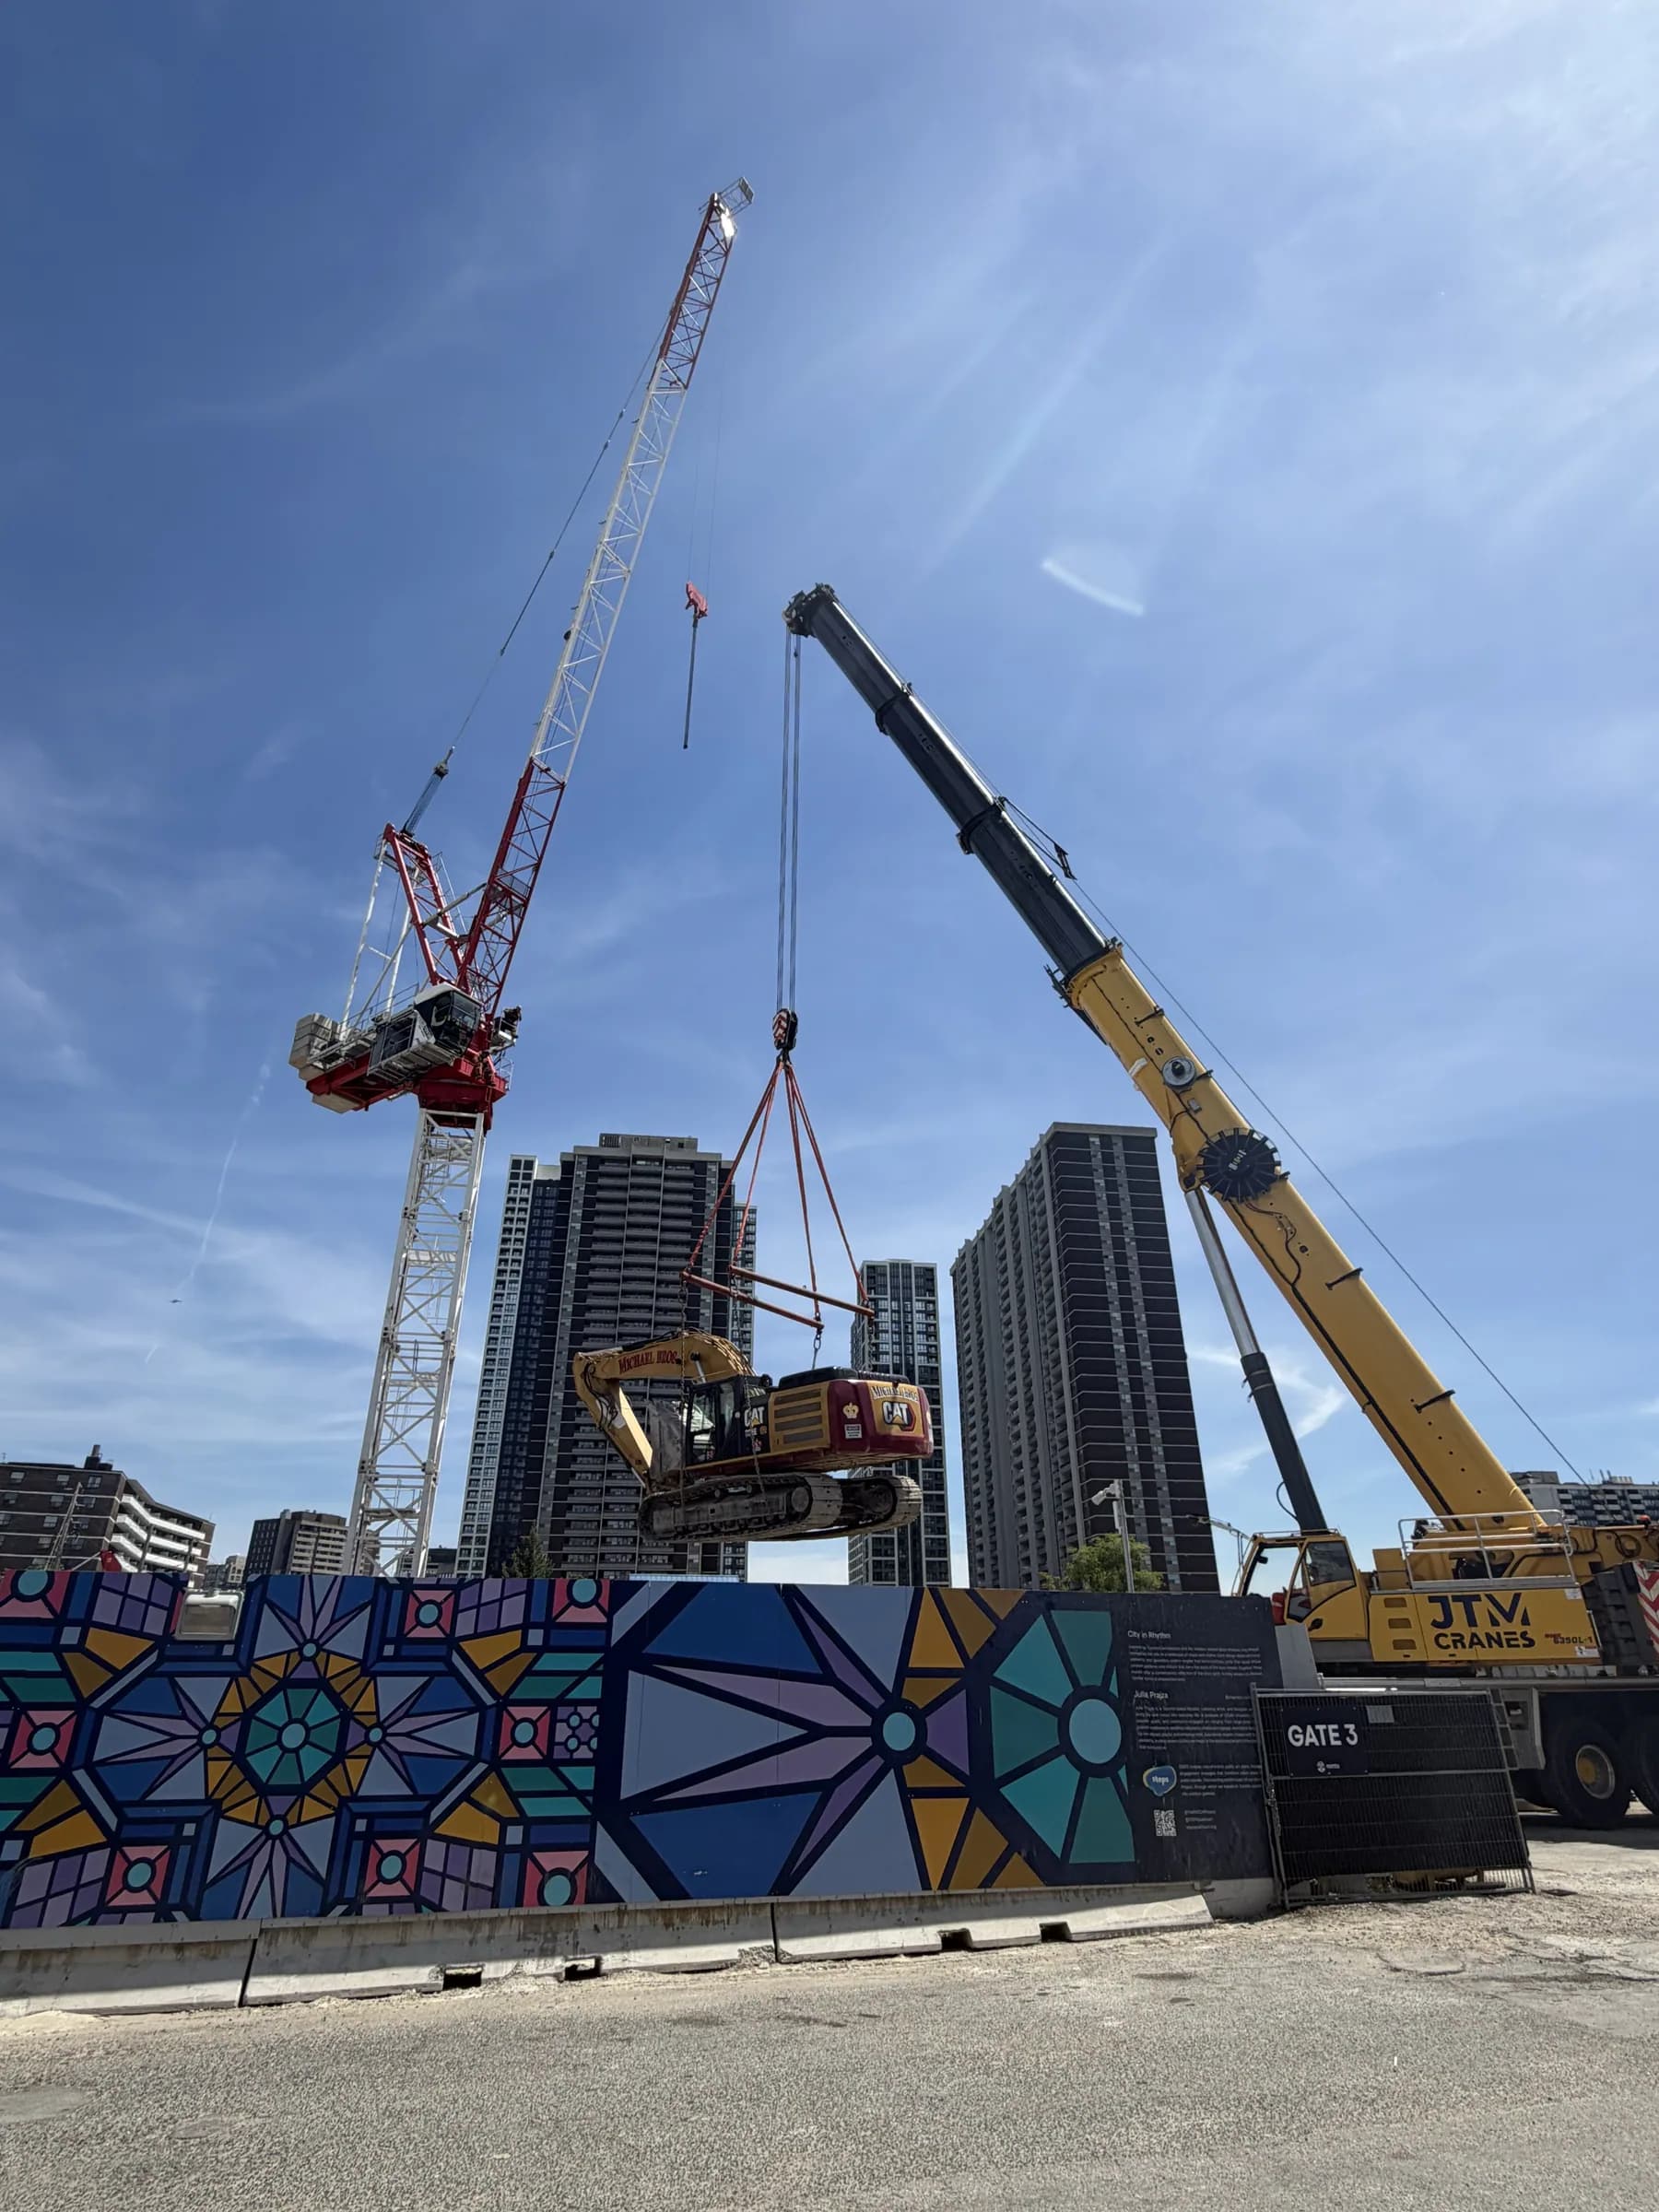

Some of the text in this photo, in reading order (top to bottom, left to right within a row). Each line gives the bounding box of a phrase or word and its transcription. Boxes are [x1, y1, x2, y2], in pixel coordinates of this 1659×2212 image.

[618, 1351, 653, 1374] MICHAEL
[744, 1406, 765, 1427] CAT
[882, 1401, 909, 1425] CAT
[1428, 1593, 1531, 1630] JTM
[1127, 1630, 1140, 1640] City
[1148, 1630, 1171, 1641] Rhythm
[1433, 1630, 1536, 1650] CRANES
[1288, 1724, 1359, 1747] GATE 3
